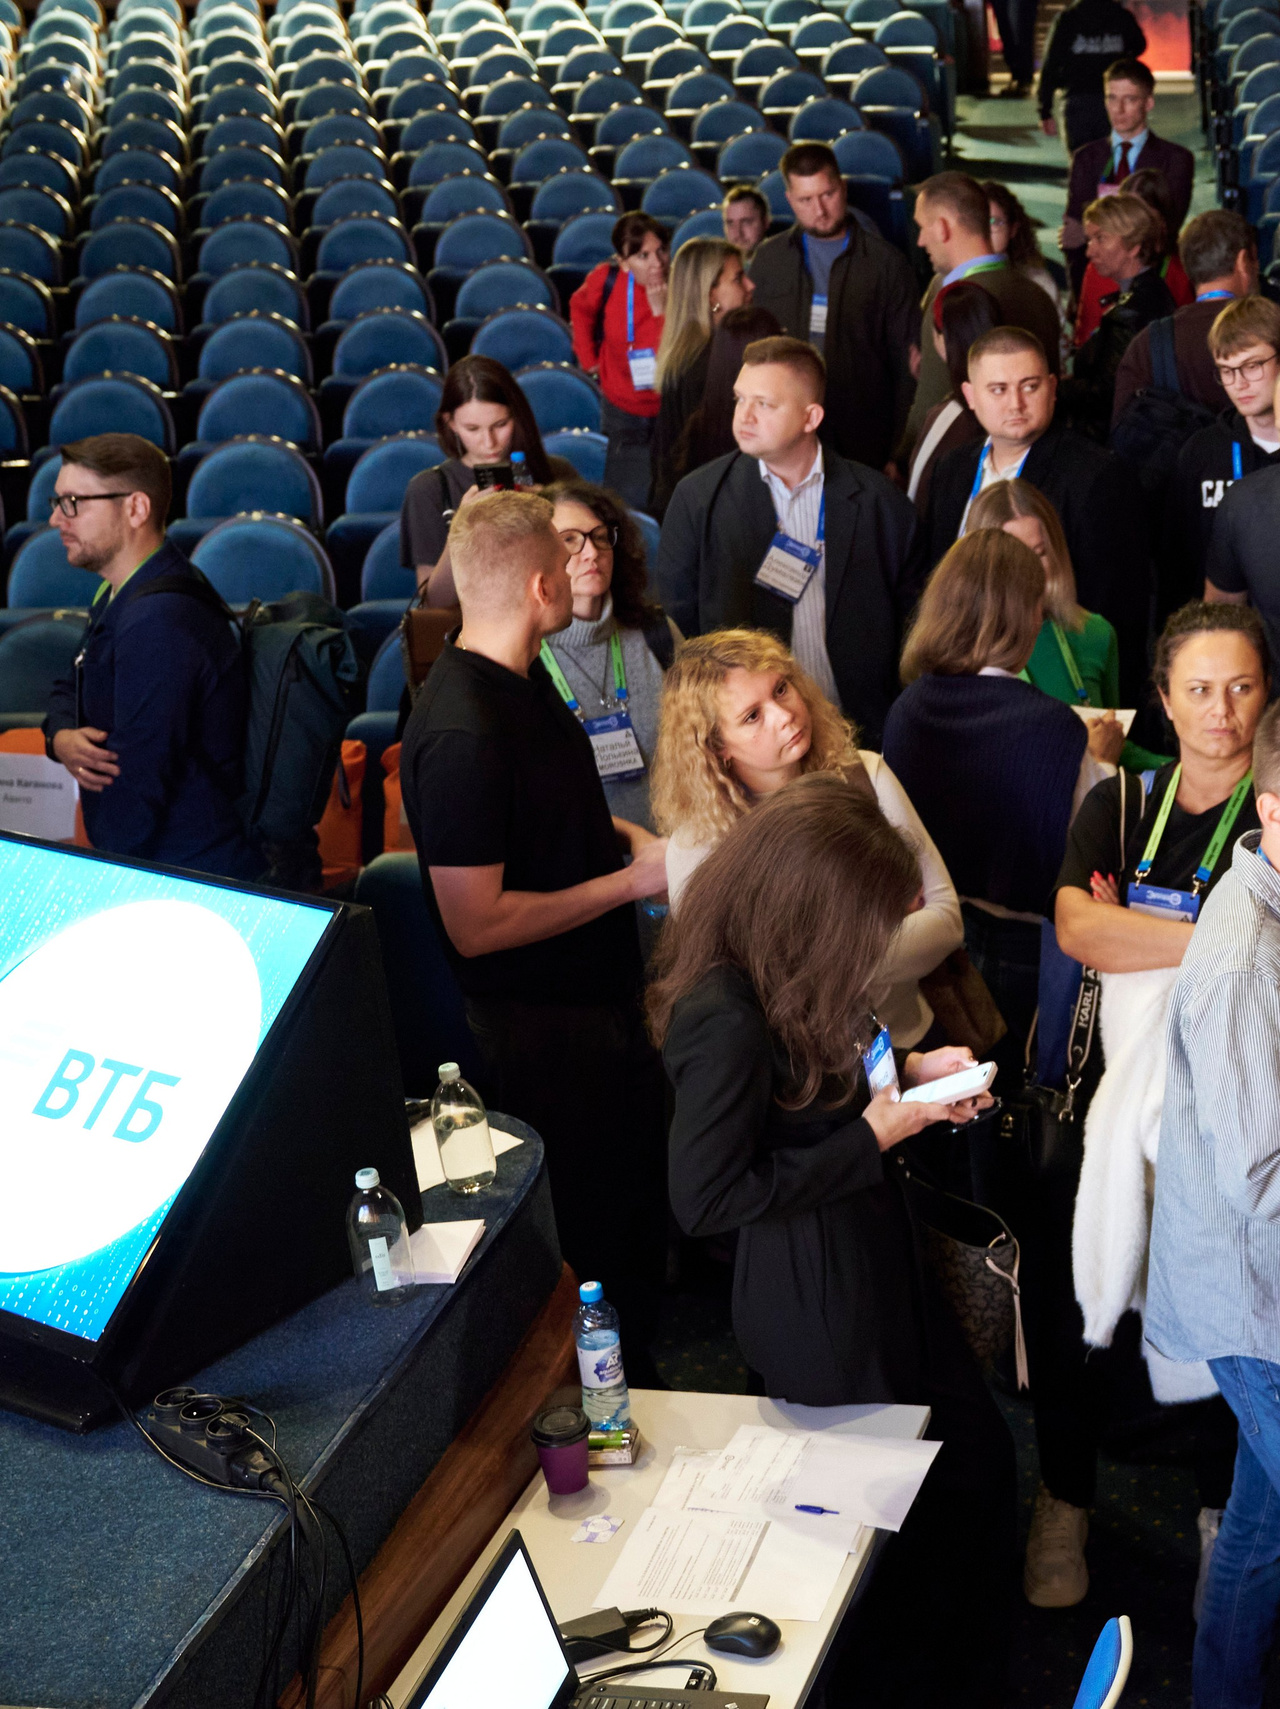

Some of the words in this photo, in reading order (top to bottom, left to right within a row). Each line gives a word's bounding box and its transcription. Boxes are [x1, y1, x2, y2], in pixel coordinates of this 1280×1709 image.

[1202, 480, 1234, 507] CA
[1078, 989, 1094, 1028] KARL
[32, 1048, 181, 1143] ВТБ
